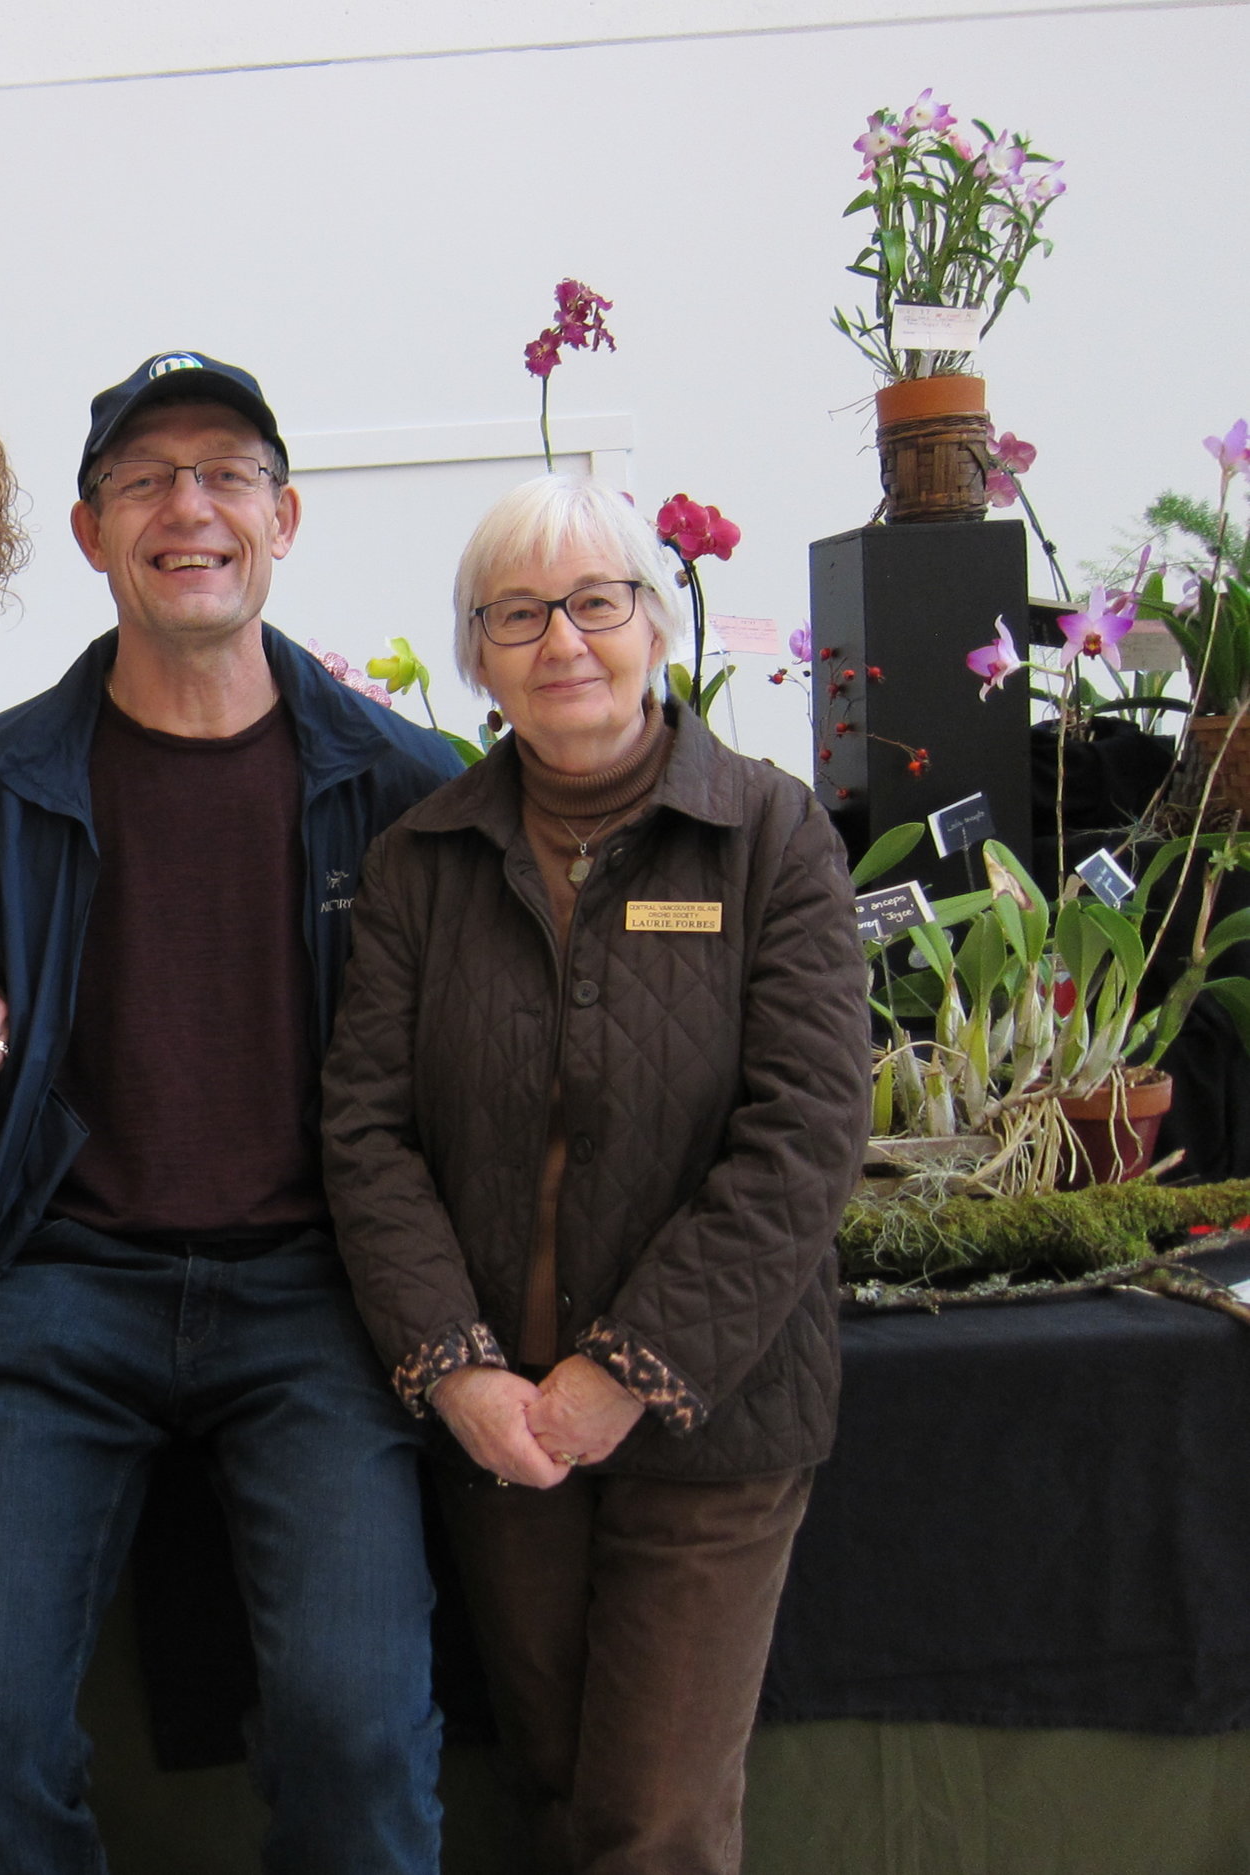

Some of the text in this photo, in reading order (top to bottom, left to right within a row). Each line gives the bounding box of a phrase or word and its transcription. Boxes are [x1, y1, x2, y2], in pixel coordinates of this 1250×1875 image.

[870, 895, 907, 911] anceps
[632, 919, 715, 929] LAURIE FORBES
